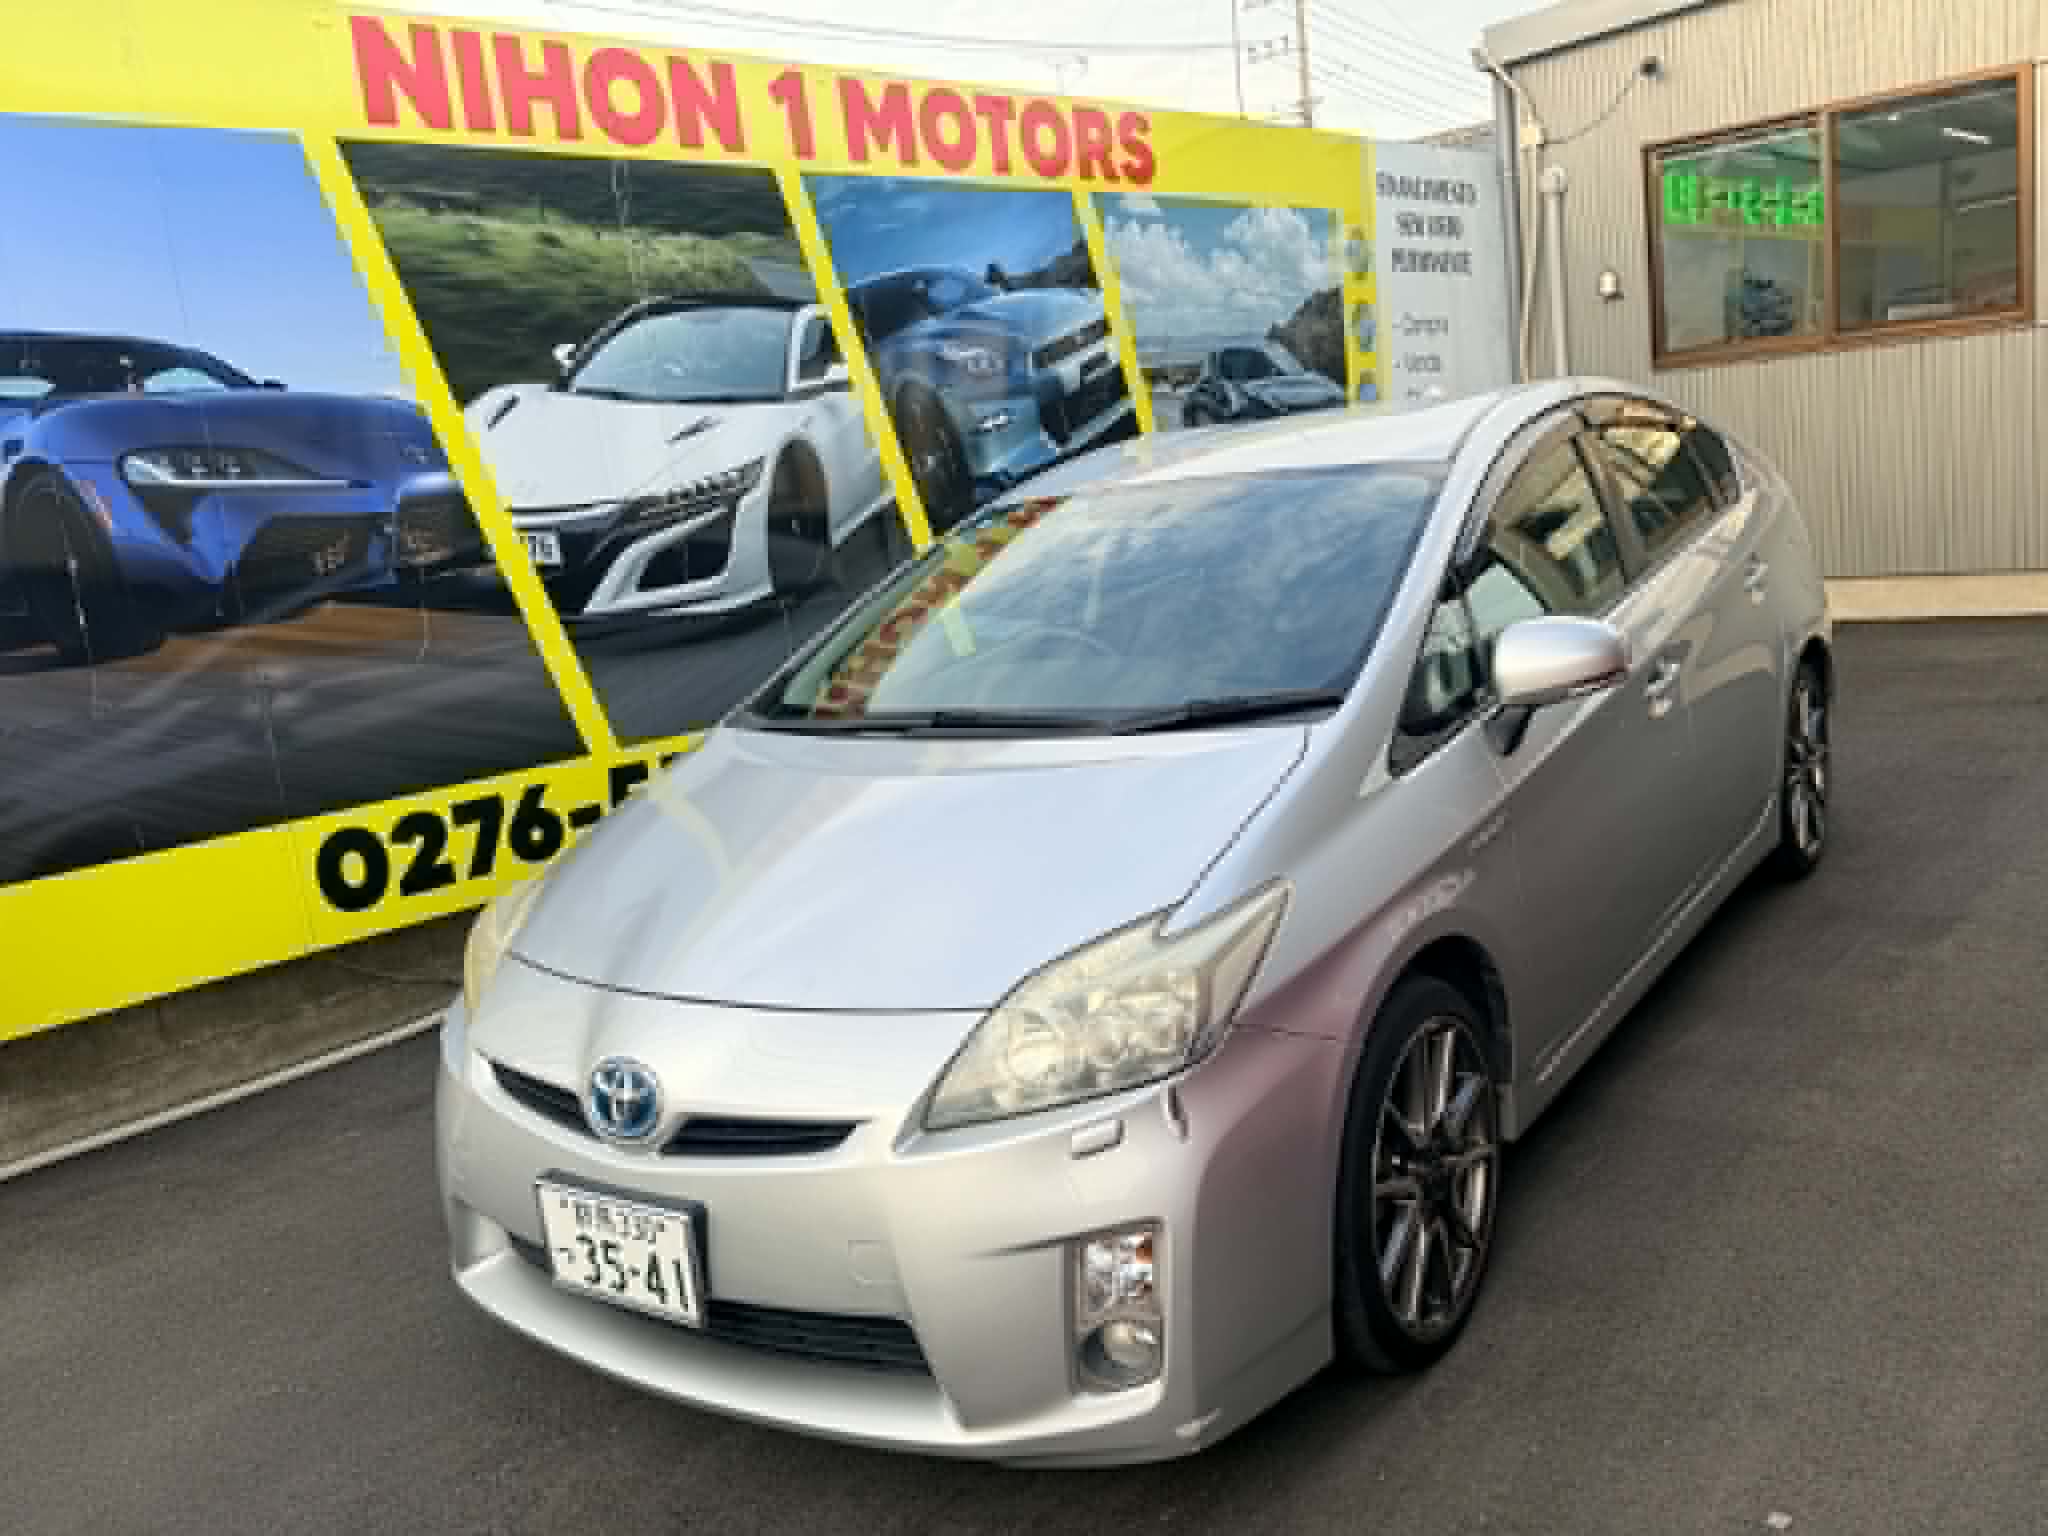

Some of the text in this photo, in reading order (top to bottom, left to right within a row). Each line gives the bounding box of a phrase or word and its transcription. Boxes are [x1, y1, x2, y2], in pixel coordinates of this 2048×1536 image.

[352, 15, 1156, 185] NIHON 1 MOTORS
[575, 1233, 691, 1313] 35-41
